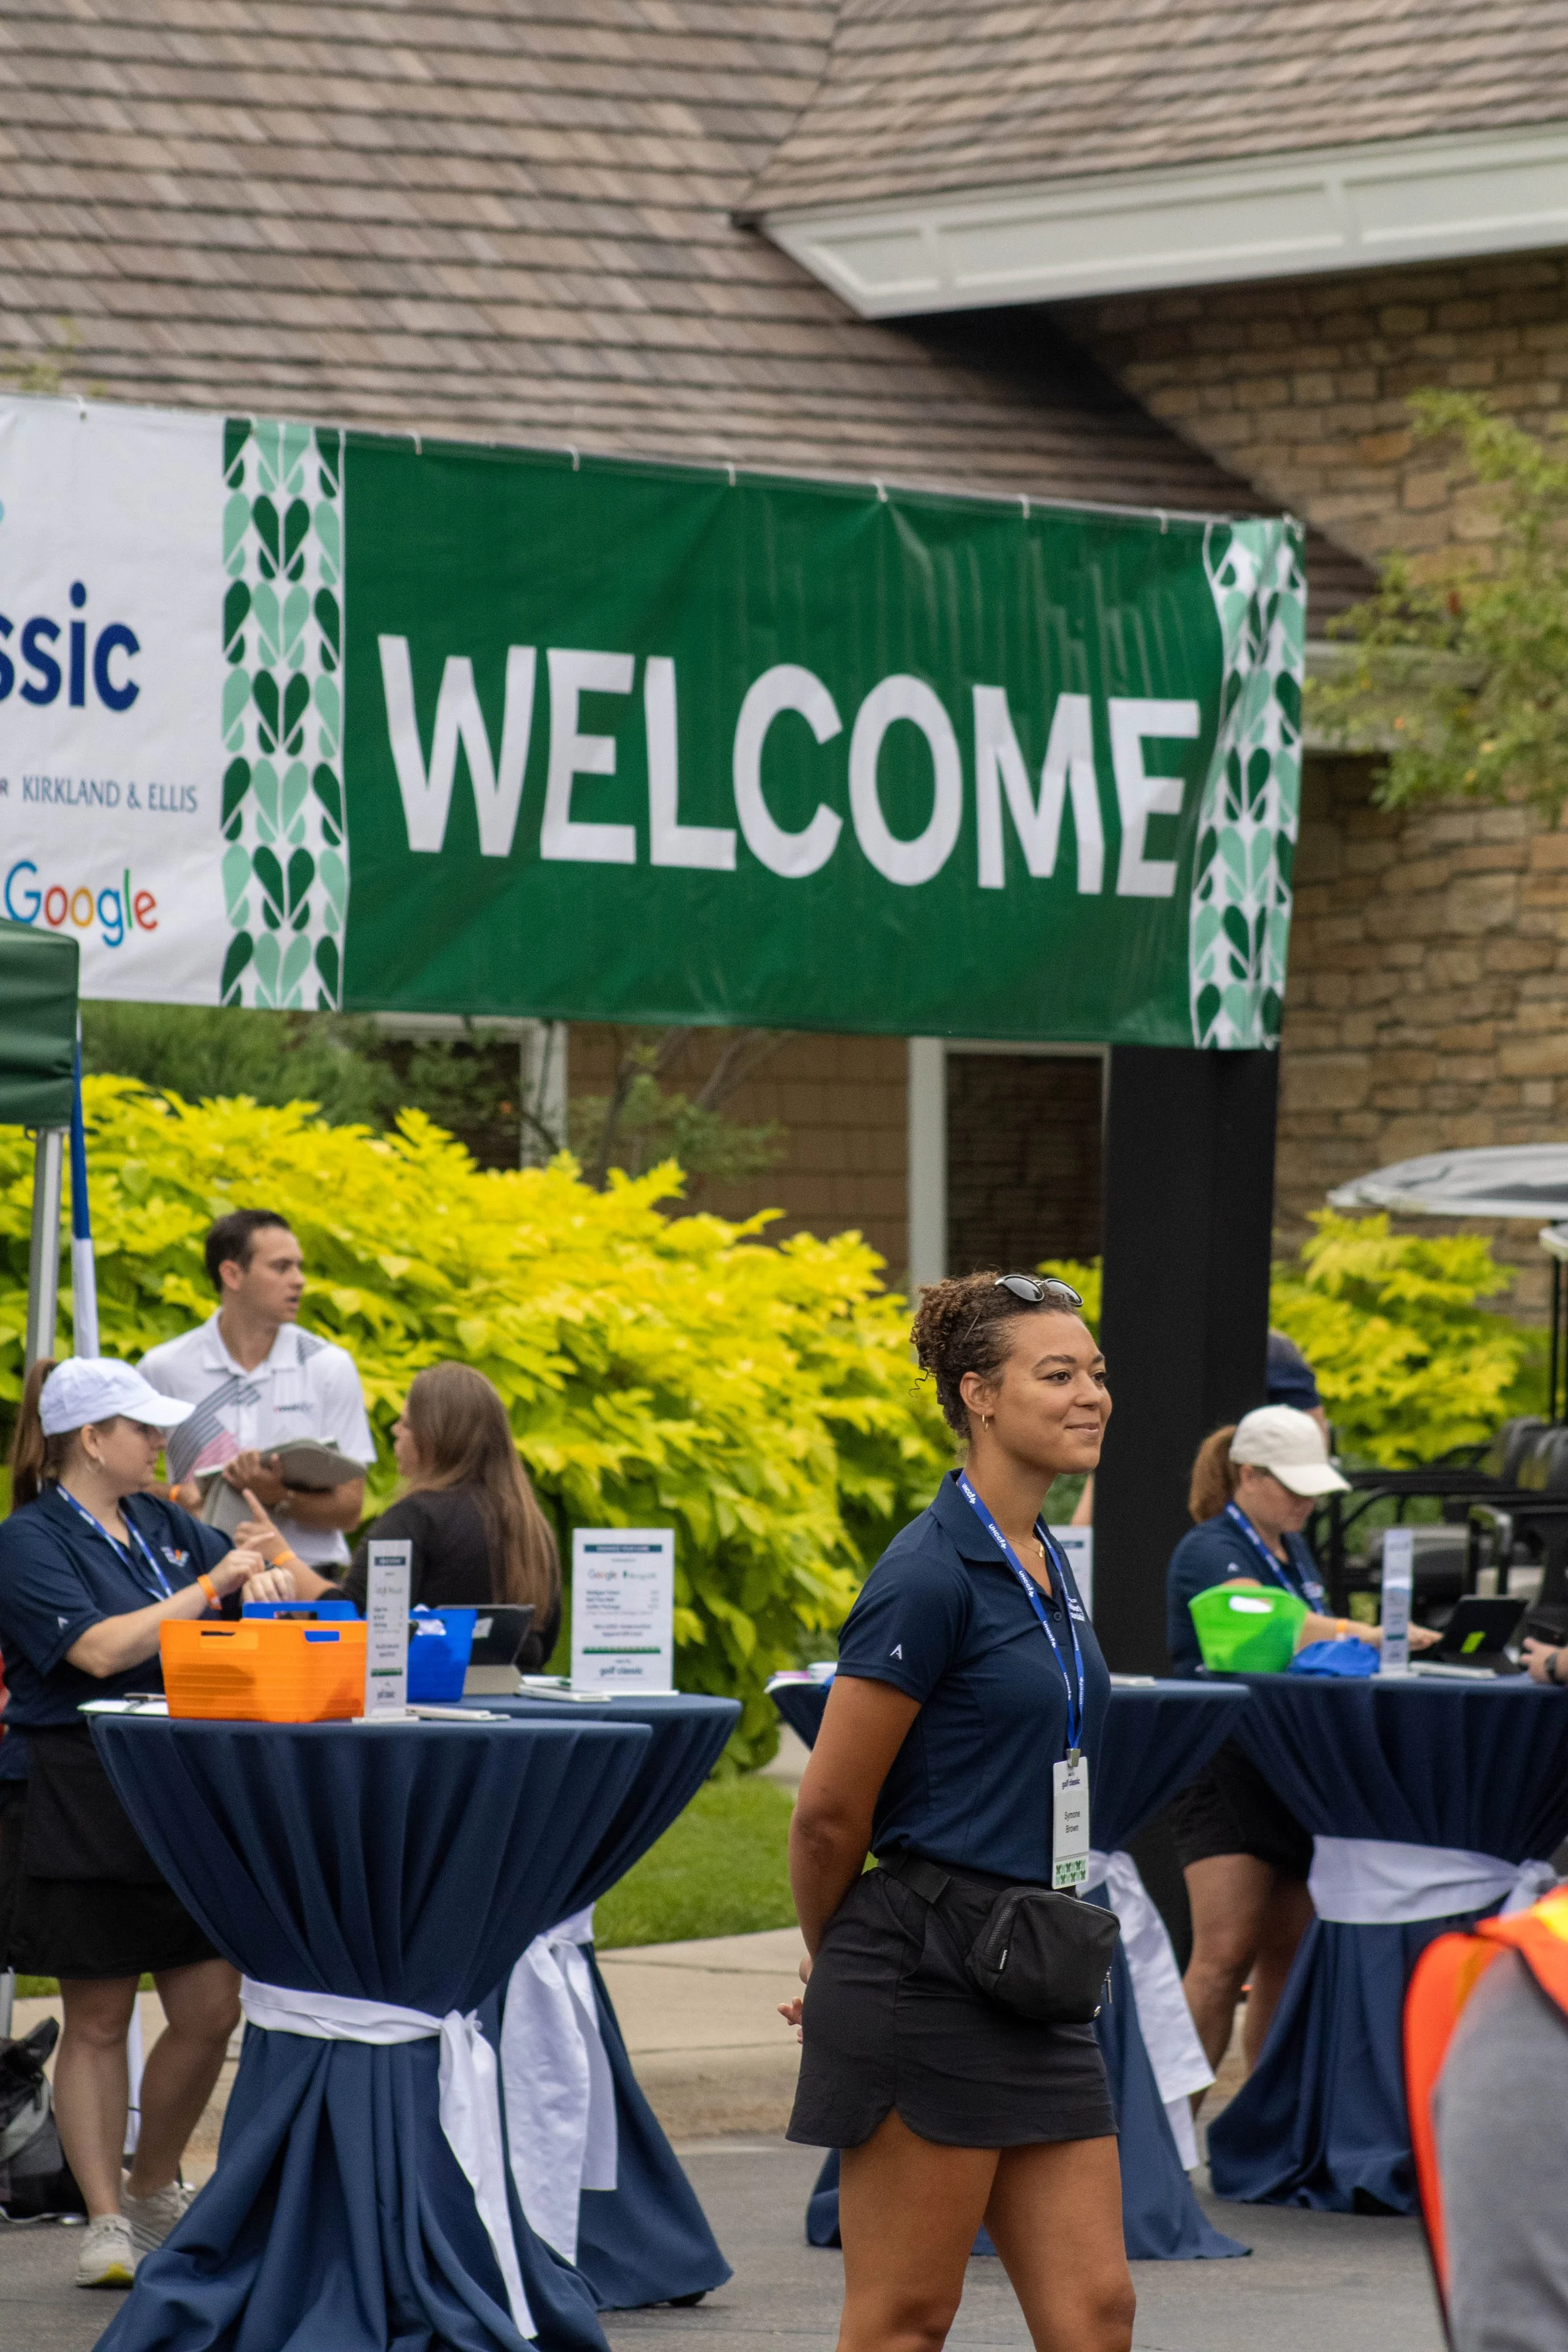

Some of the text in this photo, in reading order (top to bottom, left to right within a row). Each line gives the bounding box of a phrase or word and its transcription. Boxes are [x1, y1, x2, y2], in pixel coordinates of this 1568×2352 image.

[378, 633, 1199, 898] WELCOME
[23, 773, 121, 808] KIRKLAND
[127, 781, 142, 810] &
[148, 782, 199, 814] ELLIS
[4, 859, 159, 948] Google
[1064, 1811, 1081, 1821] Symone
[1065, 1825, 1079, 1833] Brown
